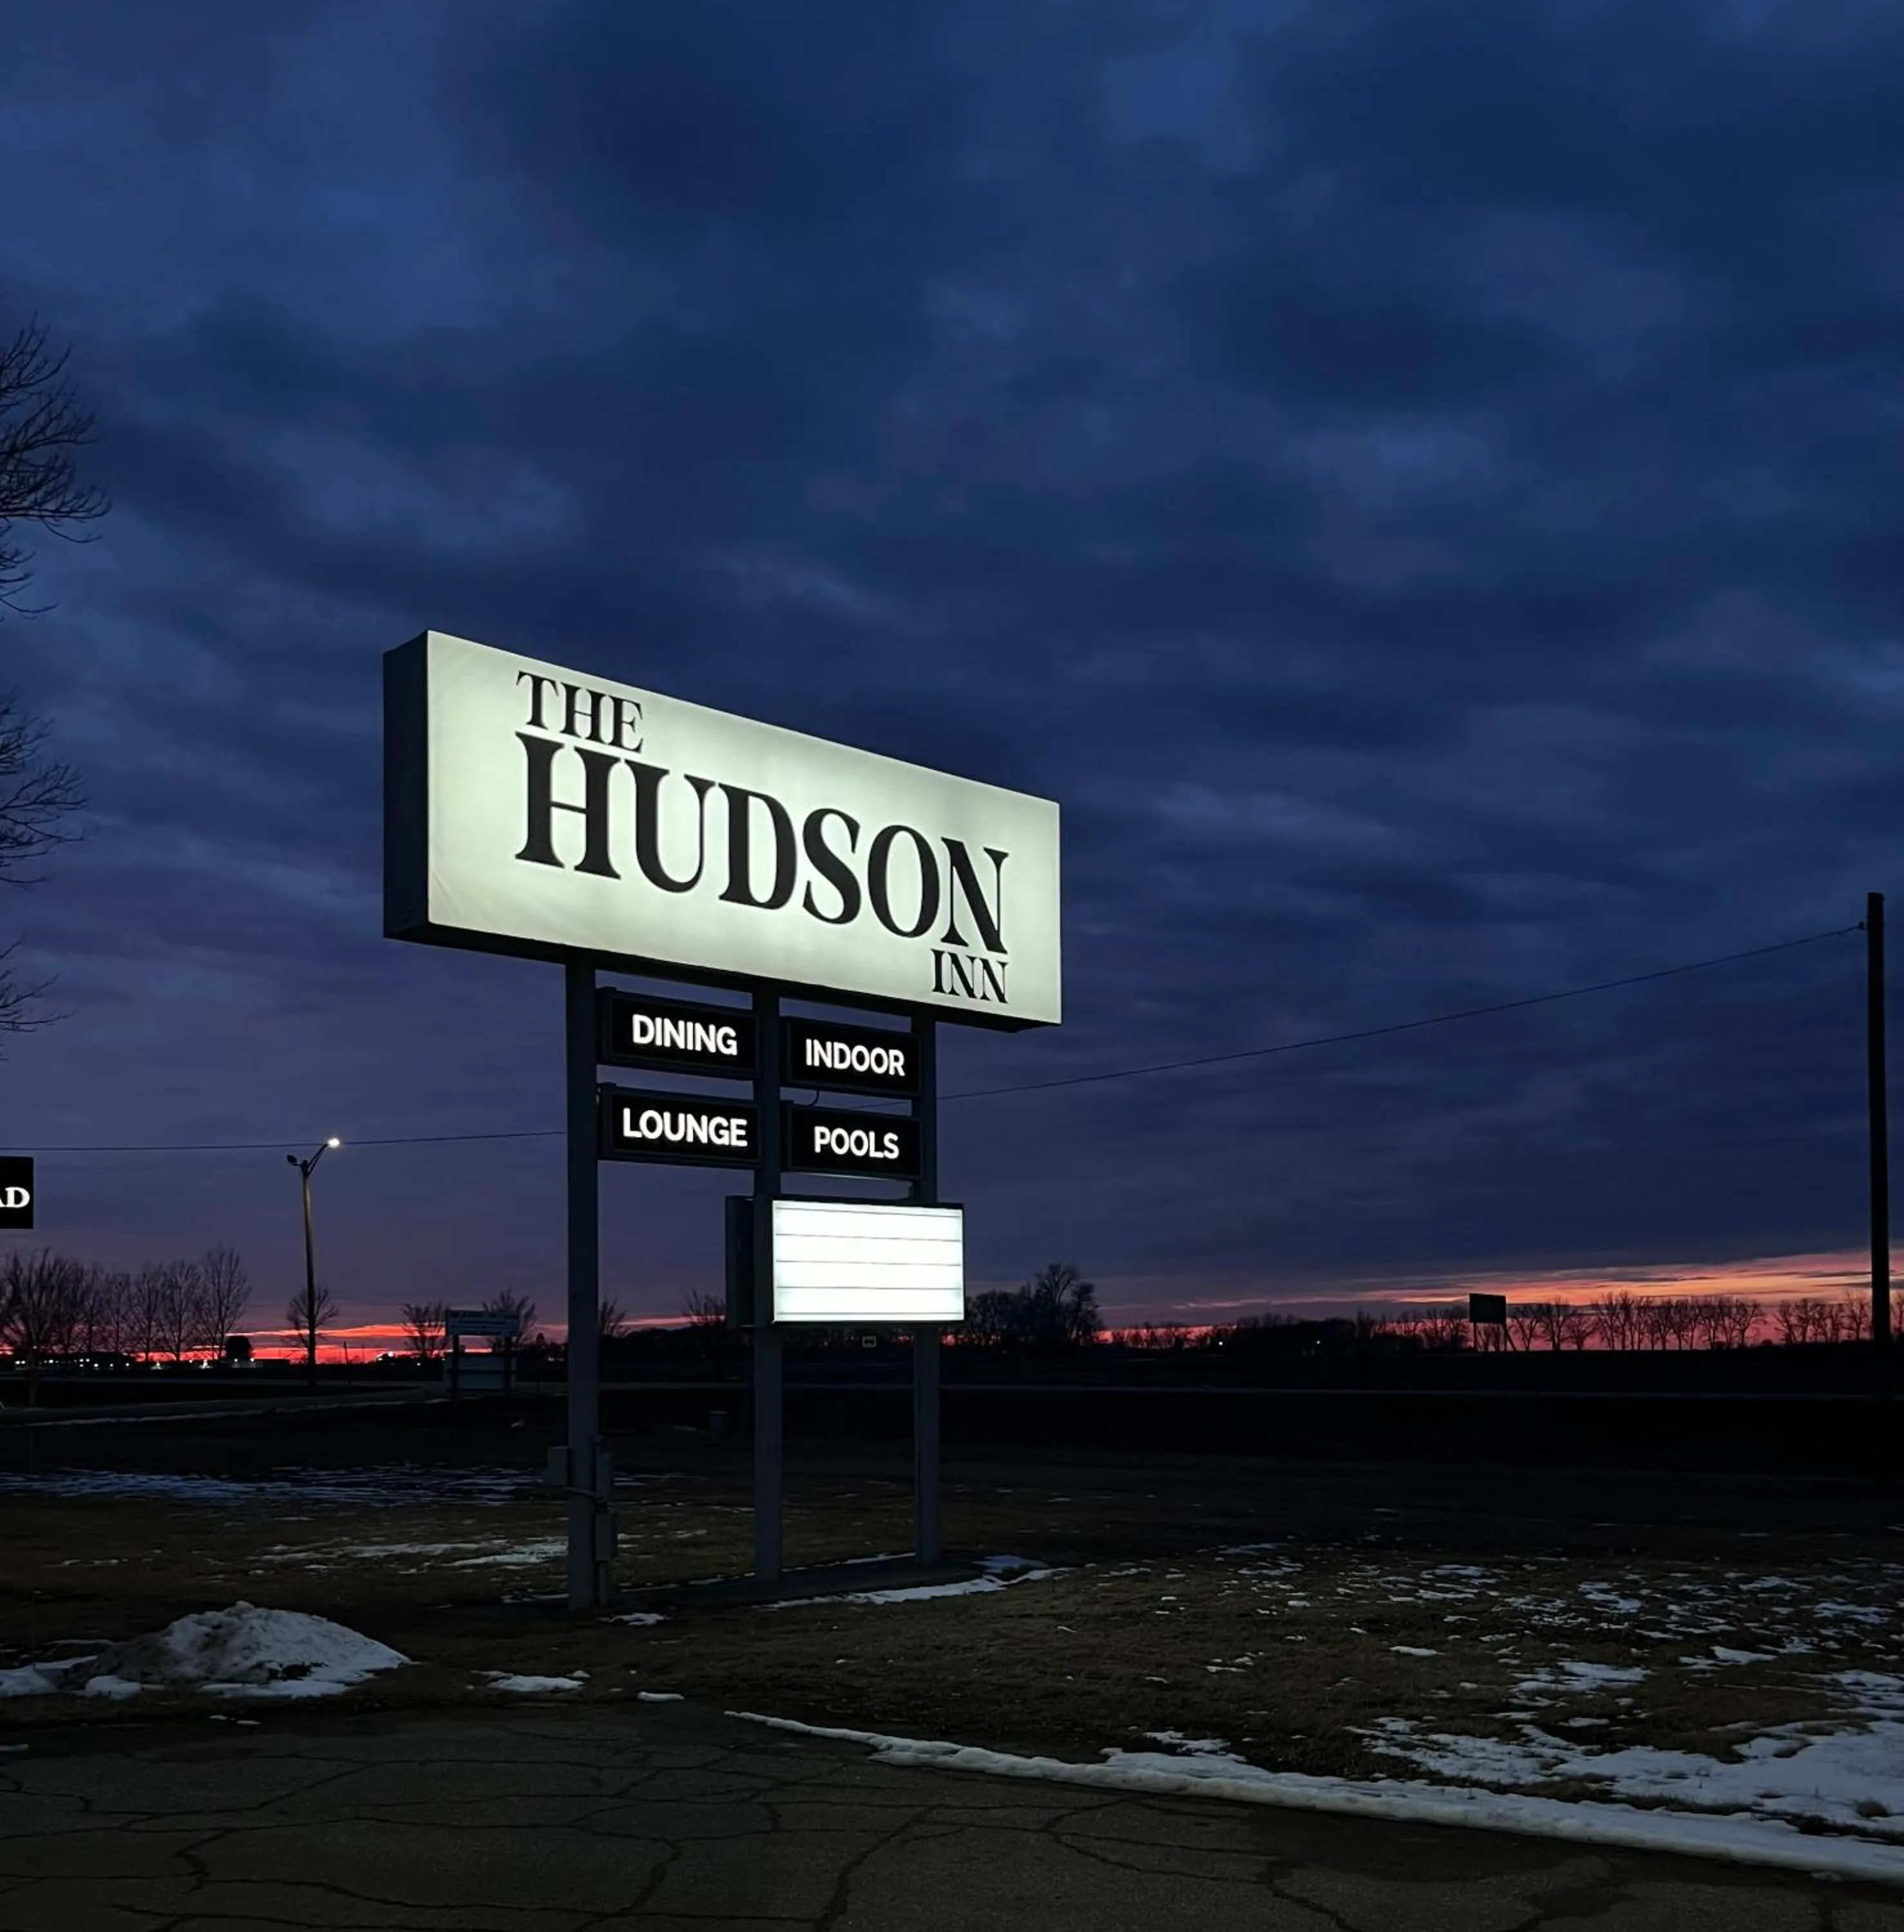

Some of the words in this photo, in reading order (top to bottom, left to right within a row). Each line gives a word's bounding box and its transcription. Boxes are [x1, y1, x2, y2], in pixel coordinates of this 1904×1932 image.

[515, 670, 643, 753] THE
[515, 732, 1009, 954] HUDSON
[931, 948, 1009, 1004] INN
[632, 1014, 738, 1056] DINING
[805, 1038, 906, 1076] INDOOR
[623, 1107, 748, 1147] LOUNGE
[814, 1126, 900, 1159] POOLS
[0, 1186, 30, 1208] D
